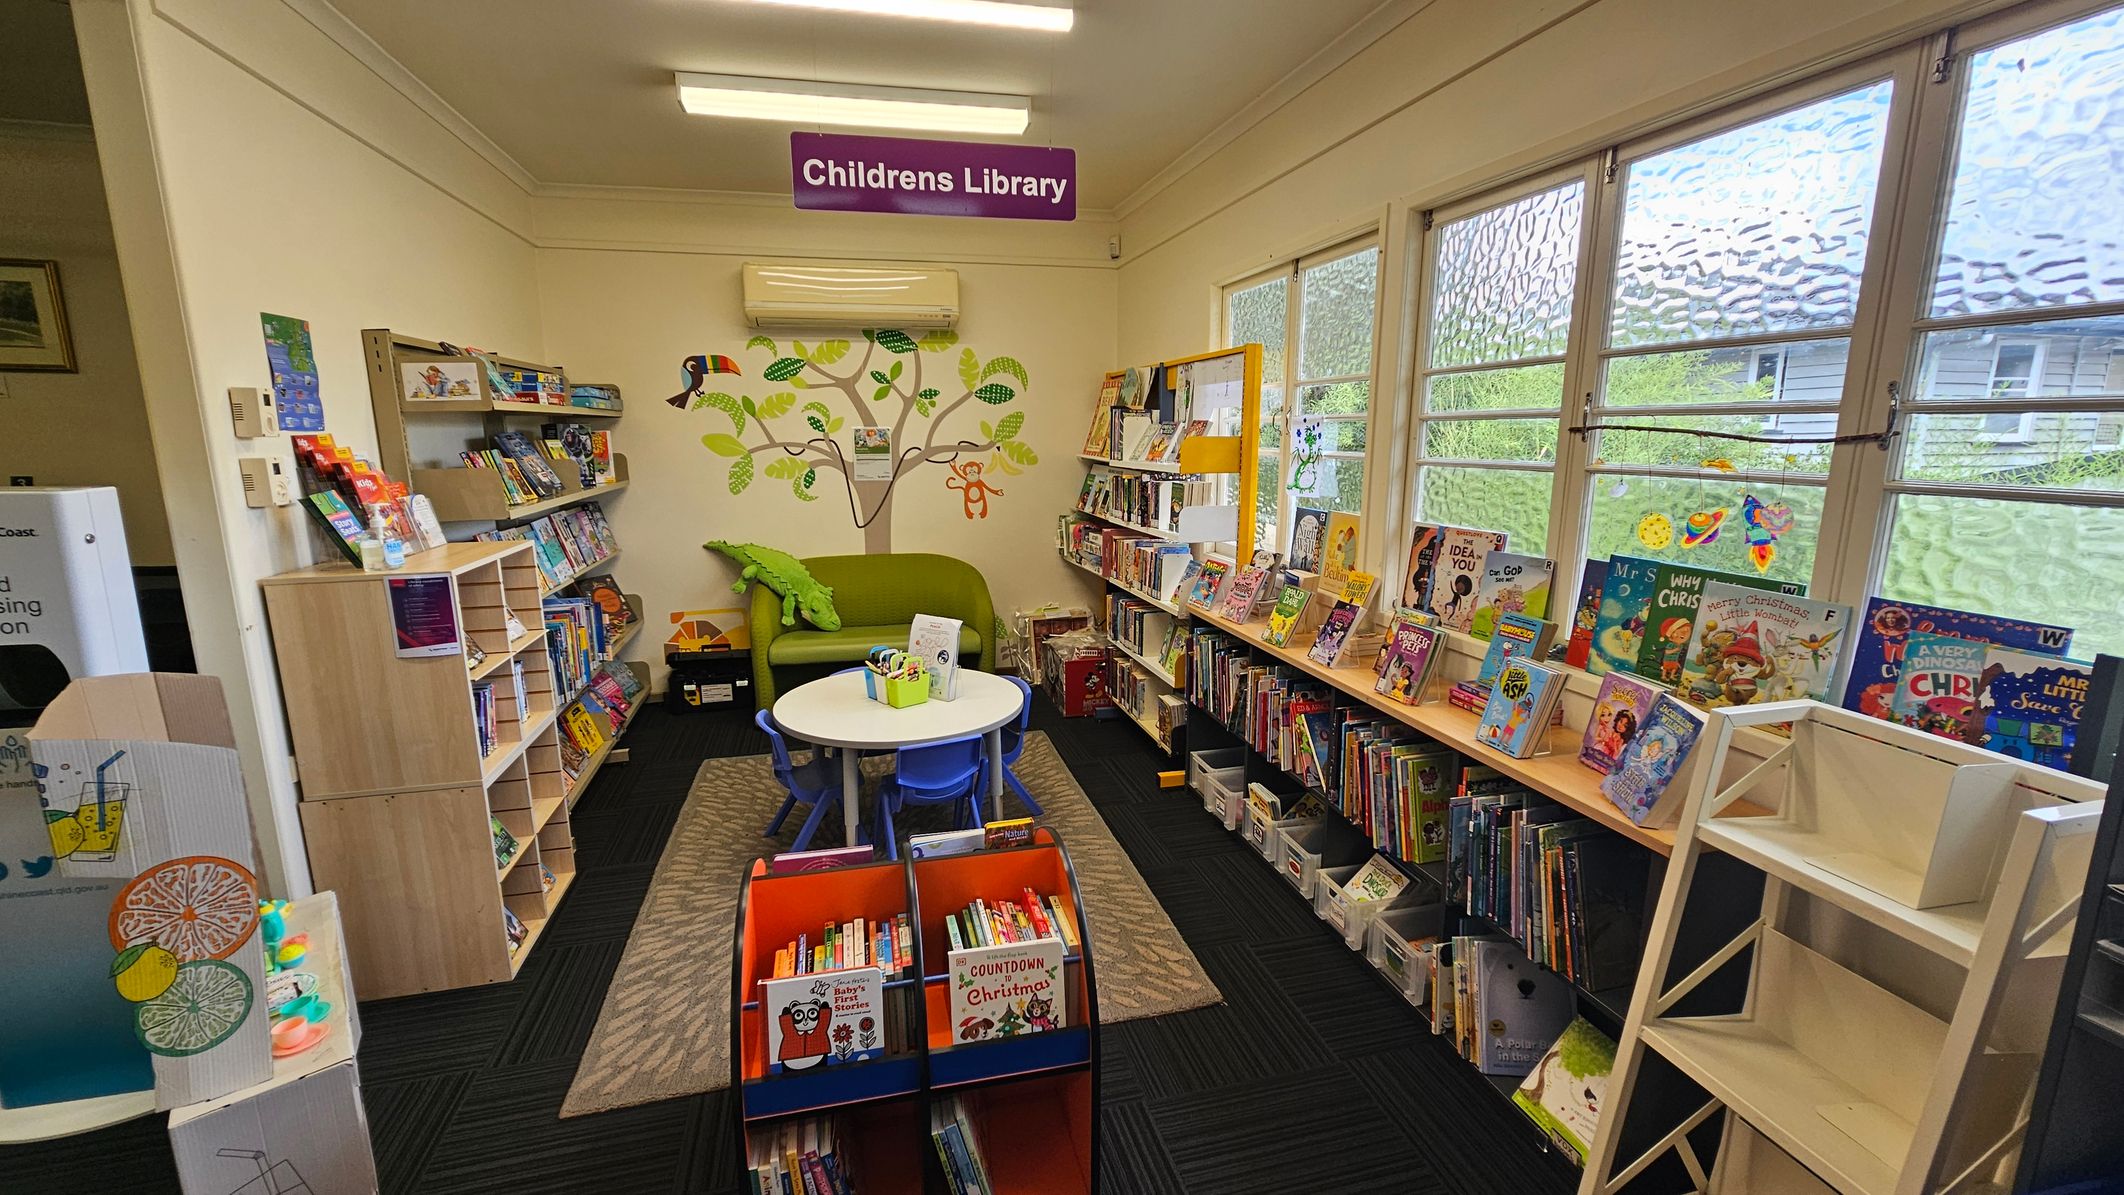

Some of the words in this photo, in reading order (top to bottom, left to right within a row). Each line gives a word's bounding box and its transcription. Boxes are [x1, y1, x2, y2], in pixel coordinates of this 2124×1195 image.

[803, 159, 954, 192] Childrens
[964, 167, 1067, 204] Library
[356, 478, 373, 489] Kids
[1450, 545, 1475, 559] IDEA
[1452, 558, 1476, 572] YOU
[1546, 561, 1552, 570] R
[1613, 562, 1639, 579] Mr
[1671, 573, 1701, 591] WHY
[1285, 587, 1304, 599] ROALD
[1344, 590, 1367, 600] TOWERS
[1782, 586, 1797, 595] W
[1282, 597, 1299, 608] DAHL
[1658, 589, 1702, 609] CHRIS
[1707, 596, 1742, 612] Merry
[1720, 608, 1750, 622] Little
[1755, 609, 1800, 630] Wombat!
[1825, 610, 1836, 621] F
[2042, 630, 2065, 646] W
[1402, 640, 1422, 653] PETS
[1918, 645, 1931, 656] A
[1933, 646, 1980, 657] VERY
[1912, 657, 1981, 671] DINOSA
[1507, 671, 1527, 683] Little
[1503, 682, 1529, 699] ASH
[2011, 692, 2061, 714] Save
[1659, 704, 1695, 733] JACQUELINE
[1661, 715, 1685, 736] WILSON
[1004, 829, 1029, 838] Nature
[970, 957, 1045, 977] COUNTDOWN
[834, 985, 866, 996] Baby's
[967, 979, 1051, 1006] Christmas
[834, 995, 858, 1004] First
[834, 1001, 870, 1012] Stories
[1495, 1039, 1505, 1049] A
[1509, 1039, 1536, 1049] Polar
[1498, 1051, 1509, 1061] in
[1512, 1051, 1530, 1061] the
